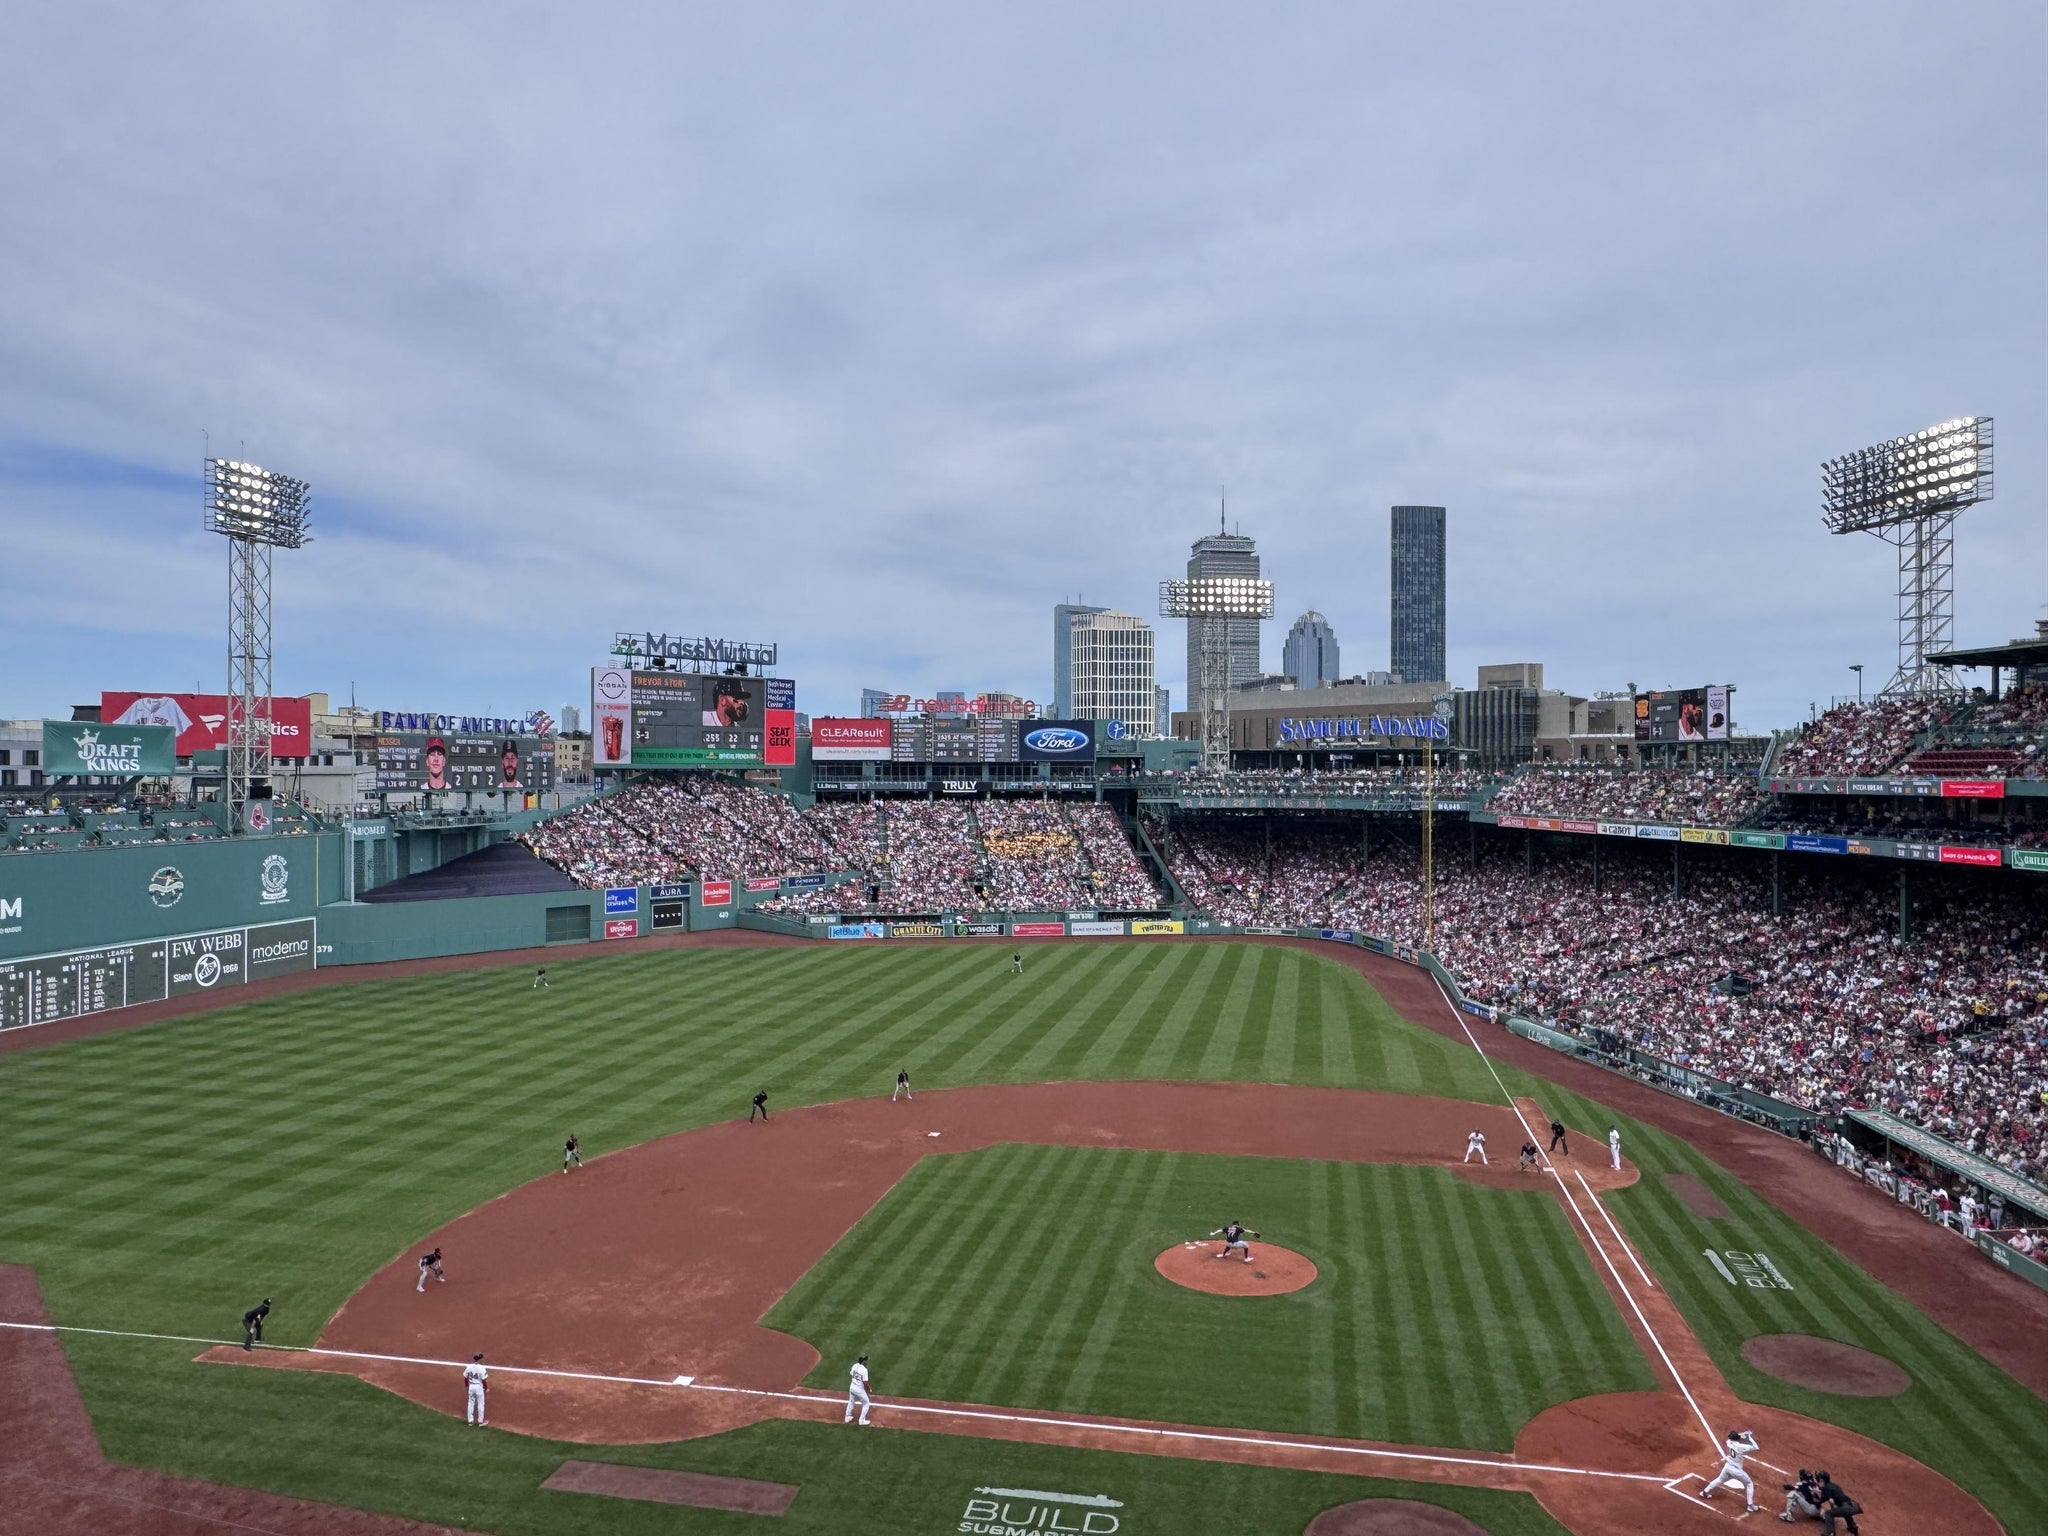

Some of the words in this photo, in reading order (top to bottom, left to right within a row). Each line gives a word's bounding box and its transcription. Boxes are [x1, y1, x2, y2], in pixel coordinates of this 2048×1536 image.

[646, 631, 777, 666] MassMutual
[633, 677, 661, 686] TREVOR
[664, 679, 687, 688] STORY
[767, 694, 786, 702] Medical
[915, 699, 951, 713] new
[955, 694, 1036, 713] balance
[382, 711, 431, 730] BANK
[436, 714, 456, 731] OF
[460, 716, 526, 734] AMERICA
[770, 727, 790, 736] SEAT
[820, 728, 884, 738] CLEAResult
[1279, 717, 1363, 743] SAMUEL
[1369, 714, 1448, 740] ADAMS
[636, 731, 649, 739] 5-3
[729, 734, 738, 742] 22
[1037, 731, 1076, 748] Ford
[769, 738, 791, 747] GEEK
[78, 742, 142, 761] DRAFT
[87, 757, 141, 772] KINGS
[455, 775, 461, 785] 2
[472, 775, 478, 785] 0
[488, 775, 494, 785] 2
[943, 780, 977, 790] TRULY
[353, 825, 386, 836] ABIOMED
[832, 926, 860, 936] jetBlue
[893, 926, 926, 936] GRANITE
[926, 925, 943, 936] CITY
[1141, 925, 1164, 933] TWISTED
[200, 933, 242, 952] WEBB
[69, 953, 104, 962] NATIONAL
[107, 948, 134, 958] LEAGUE
[252, 940, 310, 959] moderna
[173, 972, 192, 983] Since
[963, 1499, 1120, 1534] BUILD
